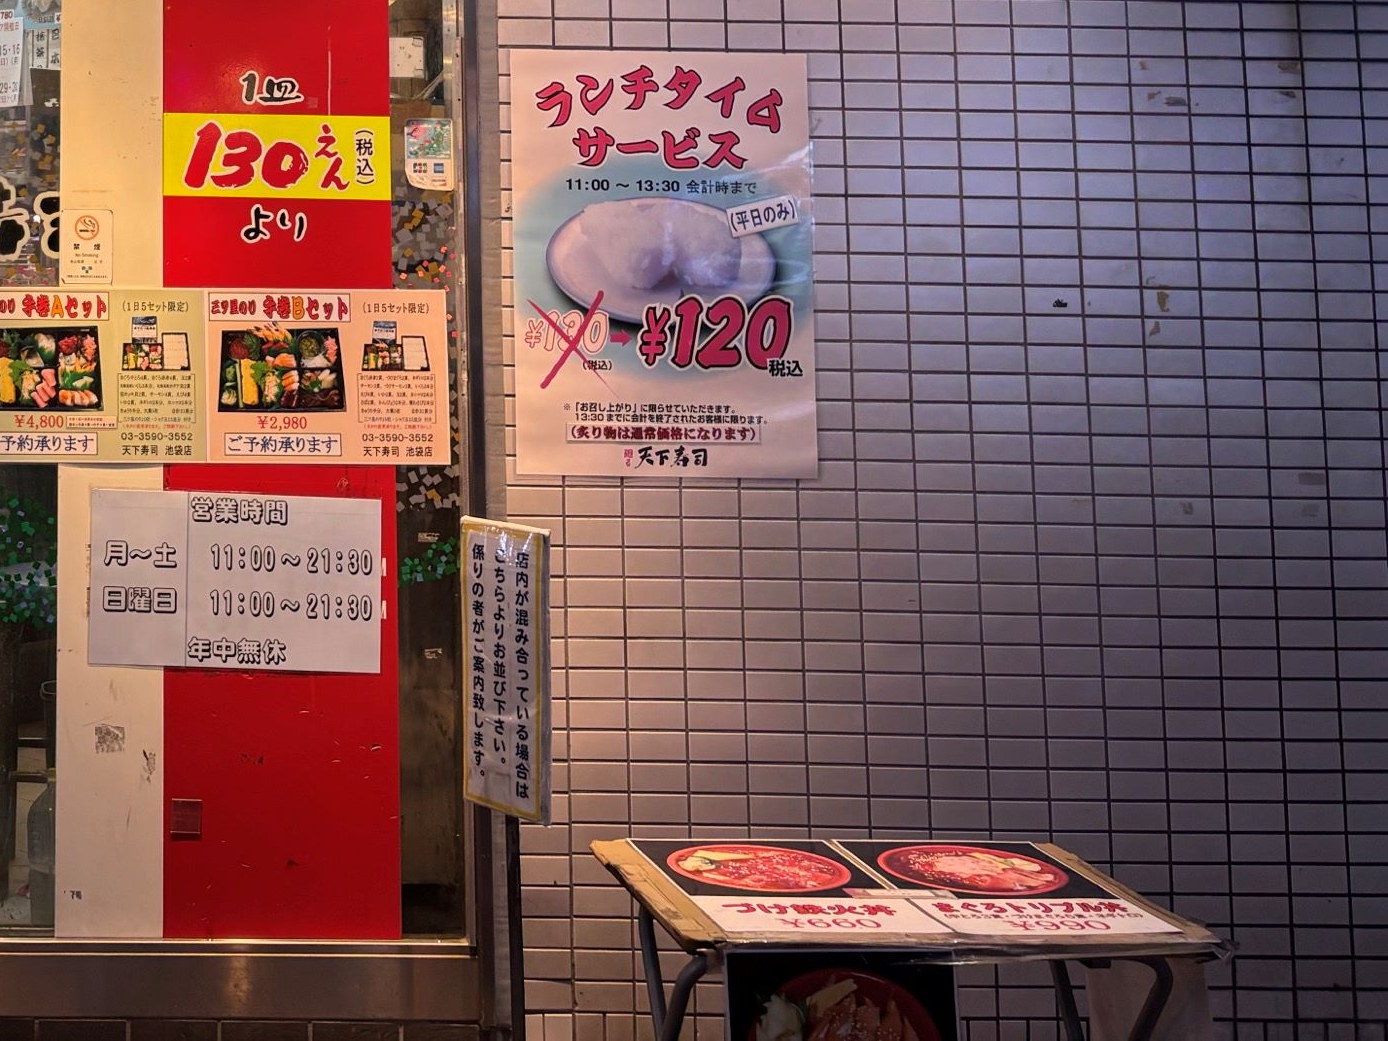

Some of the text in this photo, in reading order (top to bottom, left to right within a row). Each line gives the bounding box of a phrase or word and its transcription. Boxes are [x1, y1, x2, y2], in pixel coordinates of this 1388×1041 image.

[241, 72, 303, 104] 1皿
[535, 64, 784, 134] ランチタイム
[183, 121, 375, 191] 130えん (税込)
[572, 126, 749, 170] サービス
[565, 178, 610, 192] 11:00
[636, 180, 680, 193] 13:30
[686, 180, 758, 195] 会計時まで
[242, 205, 307, 242] より
[729, 200, 797, 232] (平日のみ)
[22, 293, 108, 319] 手巻Aセット
[262, 294, 350, 321] 手巻Bセット
[639, 295, 793, 370] ¥120
[768, 359, 804, 378] 税込
[14, 414, 64, 429] ¥4,800
[258, 415, 308, 430] ¥2,980
[120, 432, 194, 442] 03-3590-3552
[121, 444, 192, 457] 天下寿司 池袋店
[227, 435, 339, 454] ご予約承ります
[361, 432, 434, 443] 03-3590-3552
[362, 445, 433, 458] 天下寿司 池袋店
[634, 445, 709, 469] 天下寿司
[190, 496, 289, 526] 営業時間
[104, 539, 179, 569] 月～土
[102, 585, 179, 614] 日曜日
[186, 637, 288, 665] 年中無休
[472, 543, 485, 777] 係りの者がご案内致します。
[493, 548, 507, 765] こちらよりお並び下さい。
[515, 552, 530, 799] 店内が混み合っている場合は
[931, 901, 1129, 914] まぐろトリプル丼
[775, 918, 882, 929] ¥660
[1003, 919, 1112, 931] ¥990
